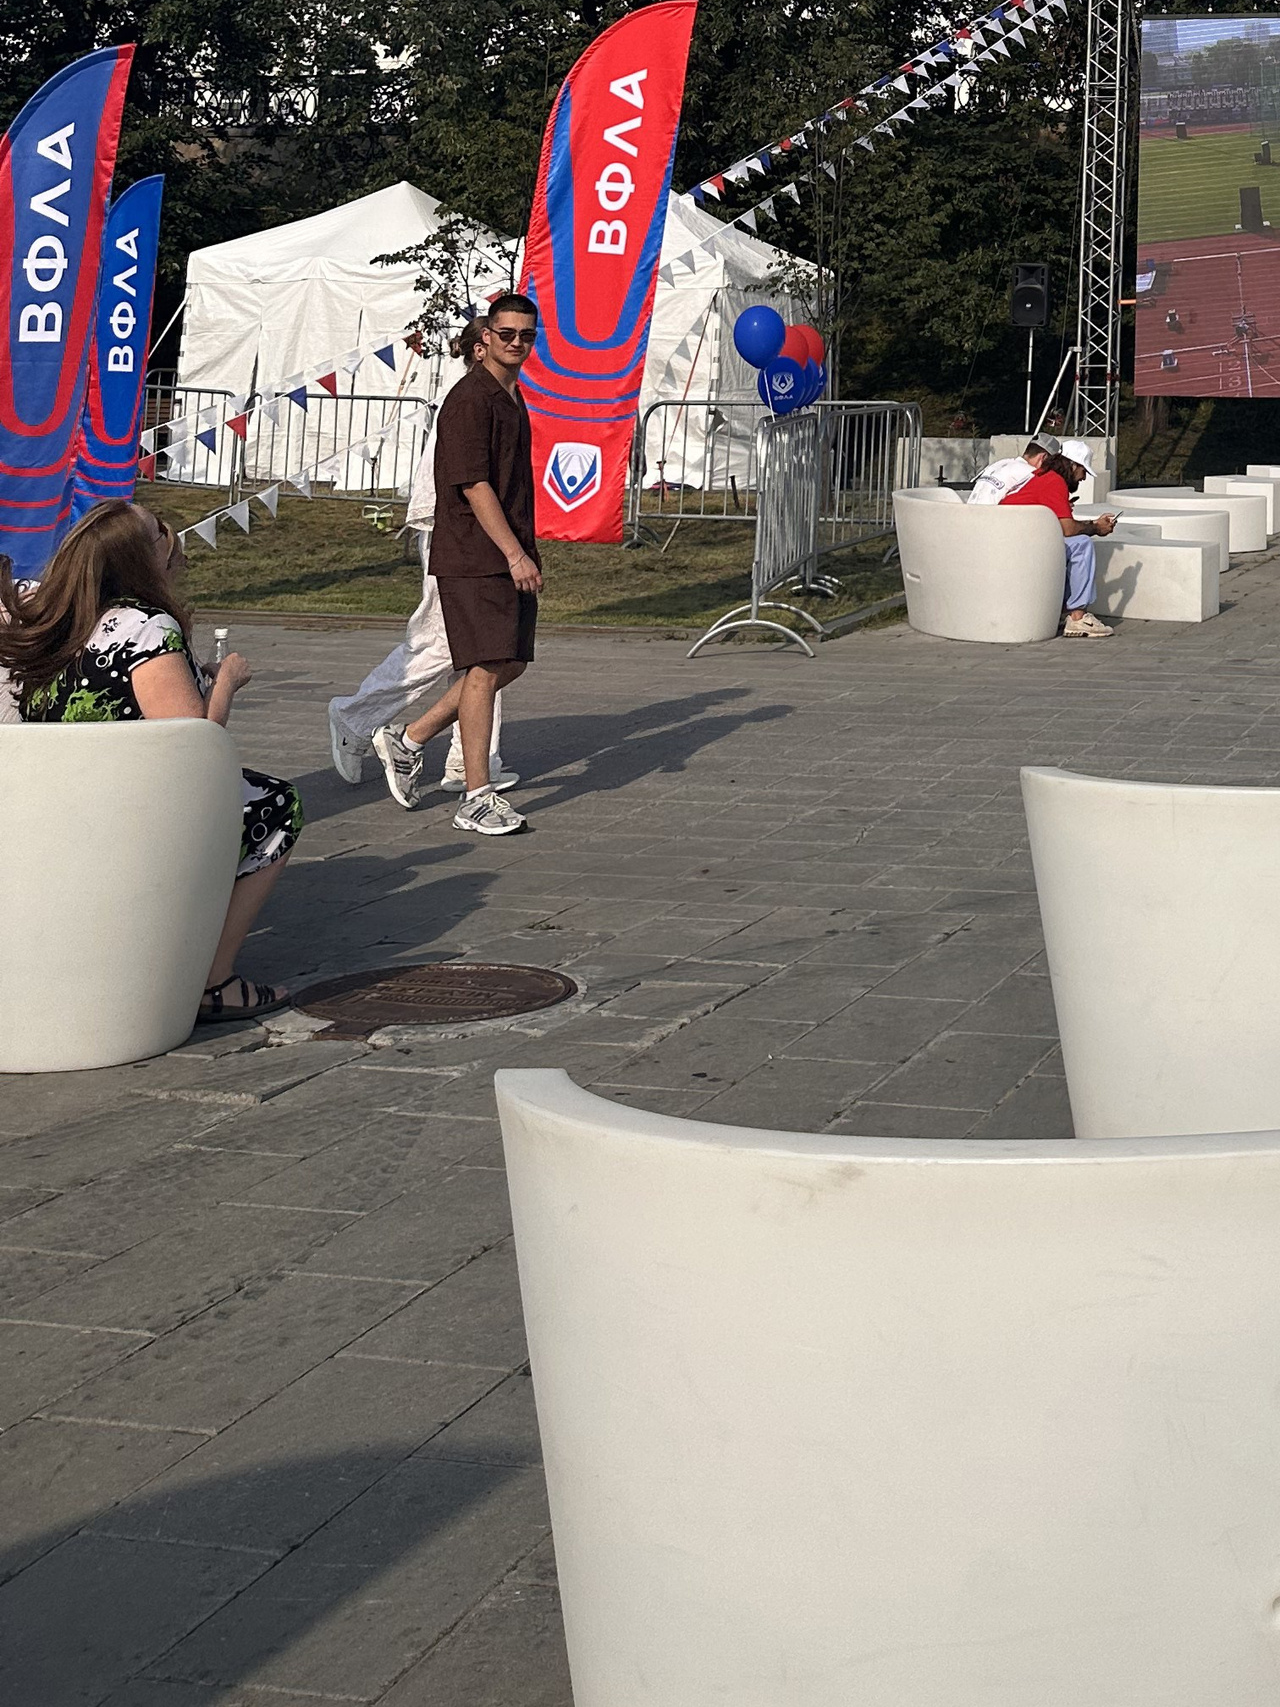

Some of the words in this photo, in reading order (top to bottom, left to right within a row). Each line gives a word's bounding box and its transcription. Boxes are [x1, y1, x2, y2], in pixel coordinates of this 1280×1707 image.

[19, 123, 75, 343] ВФЛА
[588, 69, 648, 255] ВФЛА
[108, 228, 139, 373] ВФЛА
